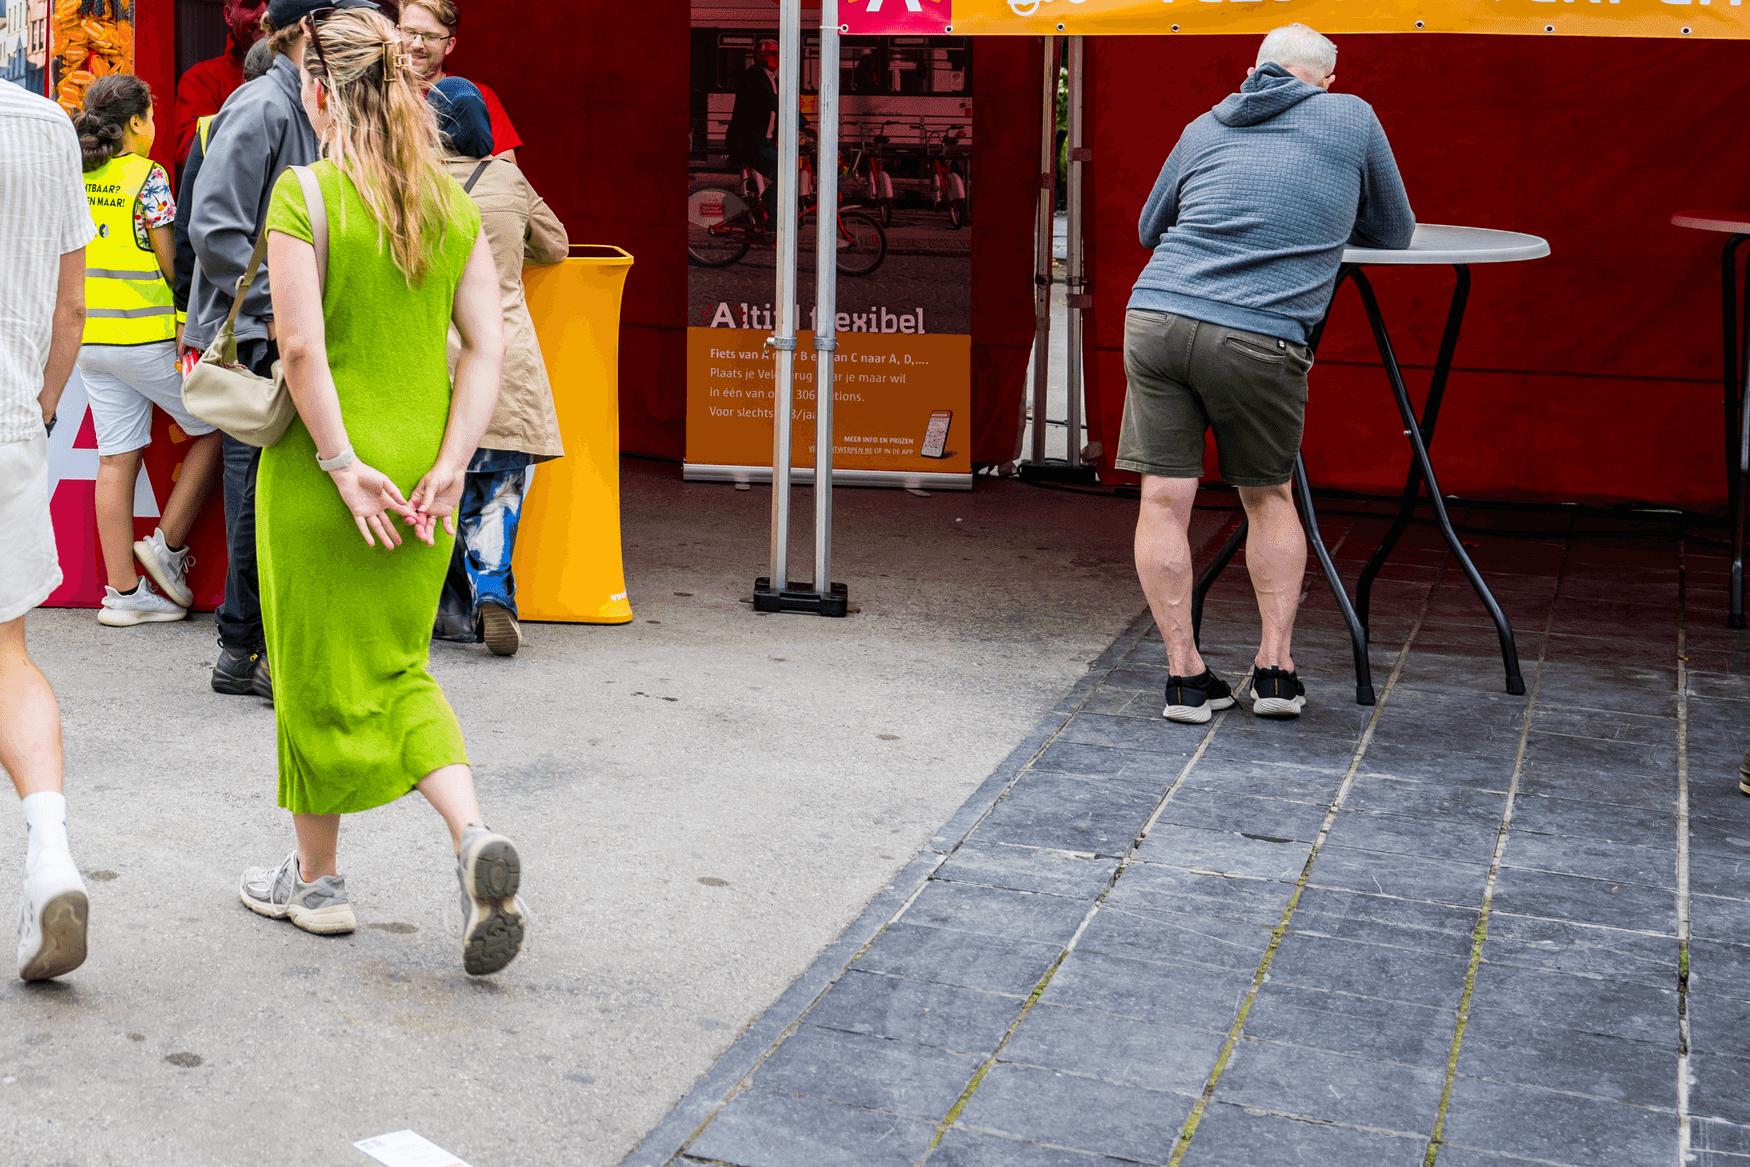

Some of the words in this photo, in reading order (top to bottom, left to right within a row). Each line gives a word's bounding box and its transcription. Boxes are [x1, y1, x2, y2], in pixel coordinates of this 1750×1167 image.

[710, 348, 736, 359] Fiets
[739, 351, 758, 359] van
[801, 352, 807, 361] B
[851, 353, 858, 362] C
[861, 355, 886, 363] naar
[710, 368, 742, 378] Plaats
[745, 369, 755, 380] je
[845, 372, 855, 383] je
[859, 375, 887, 383] maar
[890, 374, 906, 383] wil
[710, 387, 720, 397] in
[745, 390, 765, 398] van
[710, 406, 734, 416] Voor
[737, 407, 773, 418] slechts
